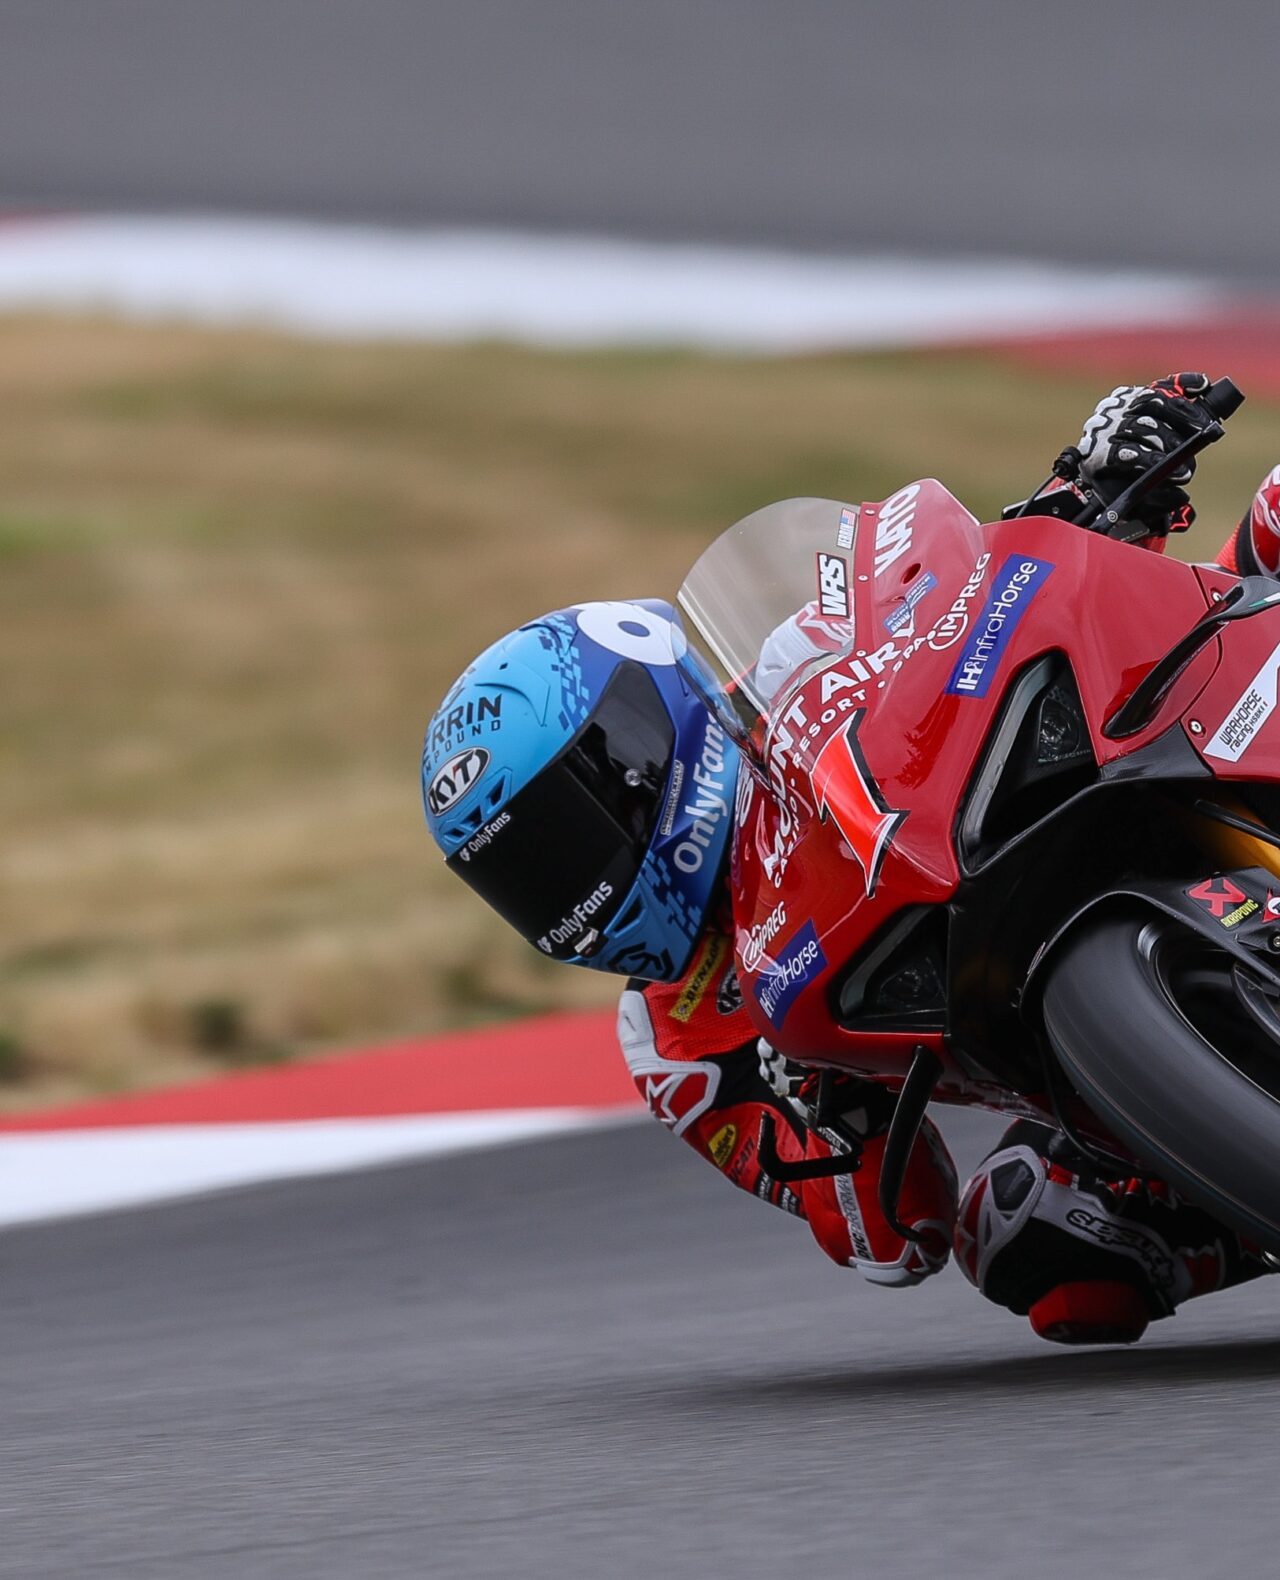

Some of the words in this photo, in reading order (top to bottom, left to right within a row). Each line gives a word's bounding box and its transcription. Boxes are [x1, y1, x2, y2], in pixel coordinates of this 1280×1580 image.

[819, 554, 847, 616] WRS
[930, 553, 991, 646] IMPREG
[968, 559, 1038, 664] InfraHorse
[820, 608, 916, 705] AIRY
[791, 688, 867, 769] RESORT
[892, 635, 927, 673] SPA
[1218, 688, 1263, 746] WARHORSE
[1227, 722, 1254, 753] racing
[429, 750, 479, 814] KYT
[468, 810, 511, 854] OnlyFans
[550, 880, 614, 945] OnlyFans
[747, 901, 786, 967] IMPREG
[763, 939, 818, 1007] InfraHorse
